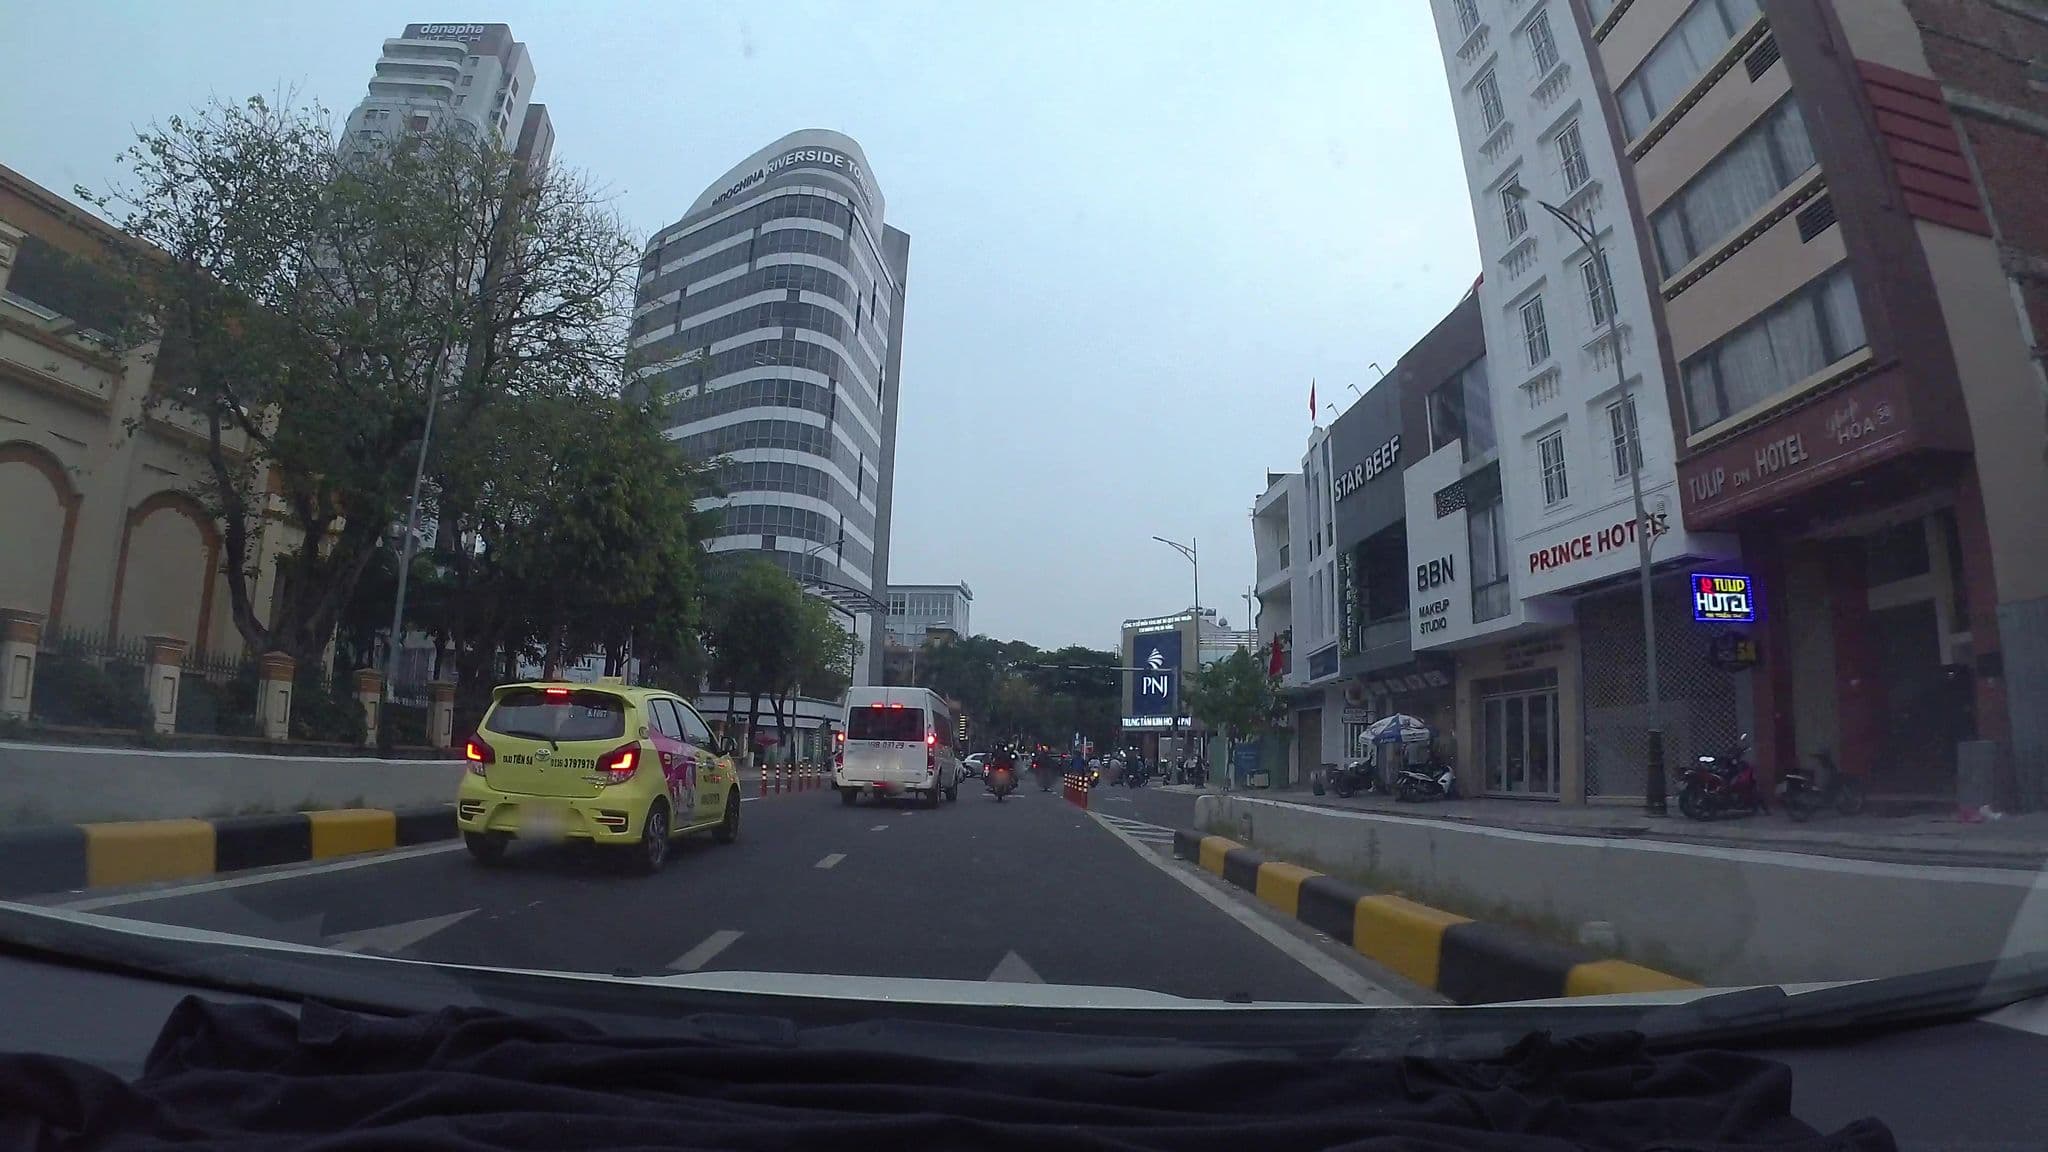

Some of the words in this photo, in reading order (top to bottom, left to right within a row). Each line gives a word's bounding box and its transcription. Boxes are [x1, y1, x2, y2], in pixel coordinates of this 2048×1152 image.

[420, 24, 484, 34] danapha
[767, 150, 845, 175] RIVERSIDE
[1334, 464, 1364, 502] STAR
[1365, 435, 1400, 481] BEEF
[1689, 468, 1725, 503] TULIP
[1755, 432, 1809, 477] HOTEL
[1529, 535, 1593, 574] PRINCE
[1416, 554, 1456, 592] BBN
[1713, 578, 1746, 592] TULIP
[1418, 598, 1450, 618] MAKEUP
[1696, 592, 1751, 612] HOTEL
[1420, 616, 1447, 635] STUDIO
[1142, 675, 1168, 698] PNJ
[564, 758, 595, 770] 3797979
